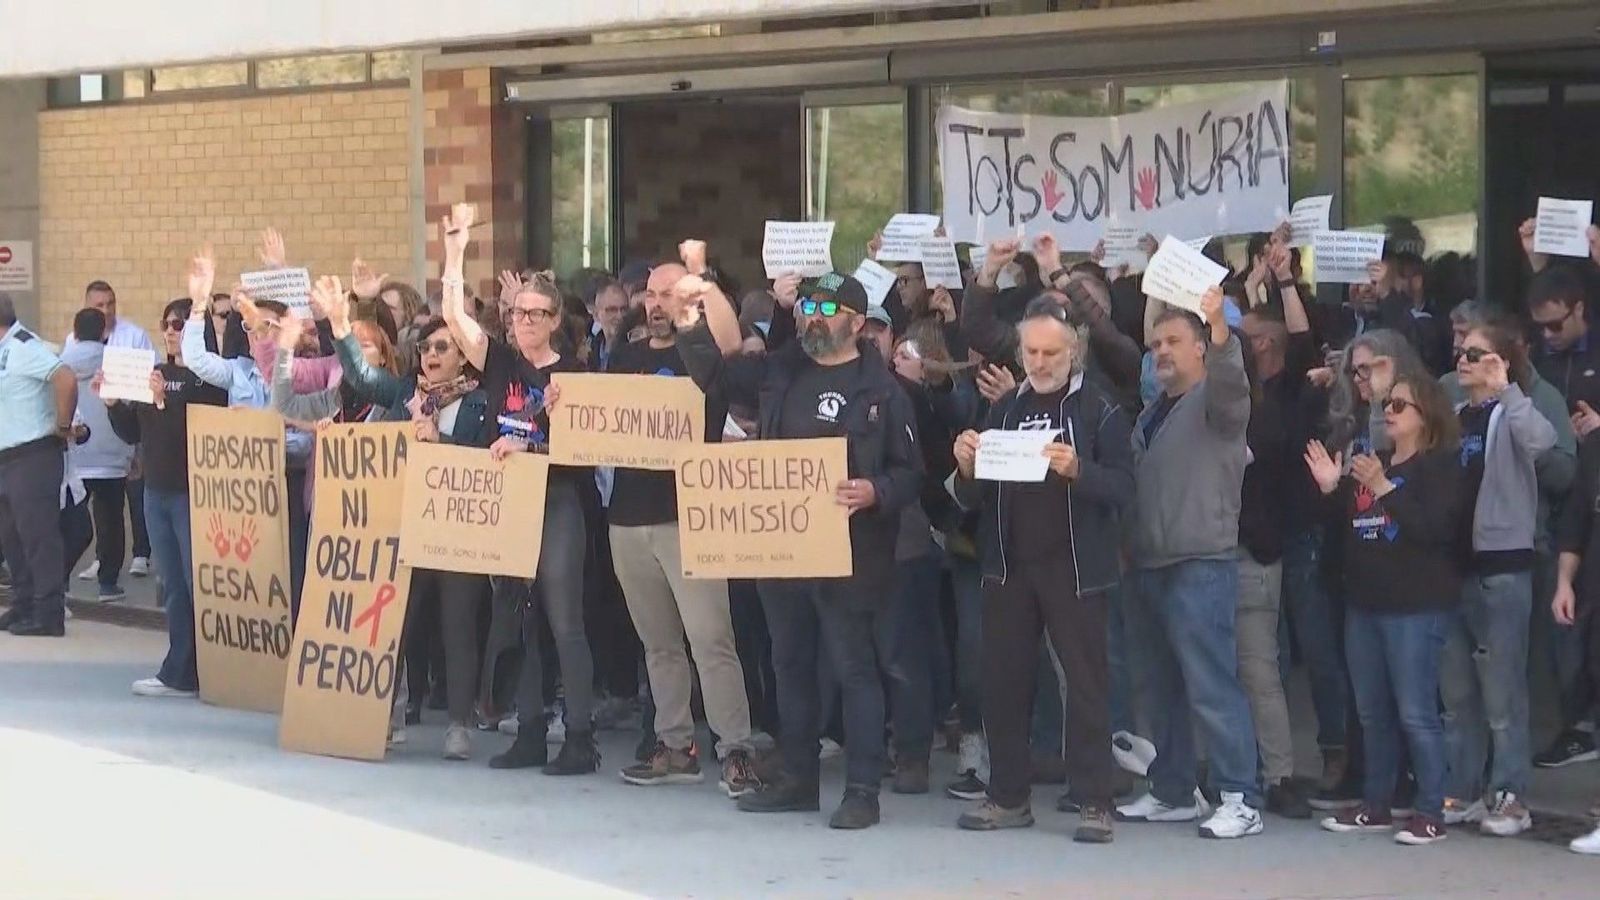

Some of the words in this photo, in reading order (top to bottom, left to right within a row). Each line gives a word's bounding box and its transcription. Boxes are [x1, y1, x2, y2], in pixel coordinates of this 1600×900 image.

[1155, 100, 1287, 208] NÚRIA
[565, 404, 607, 433] TOTS
[611, 405, 642, 434] SOM
[647, 403, 693, 442] NÚRIA
[194, 433, 279, 472] UBASART
[321, 427, 408, 480] NÚRIA
[194, 473, 279, 518] DIMISSIÓ
[425, 463, 506, 496] CALDERÓ
[681, 457, 830, 493] CONSELLERA
[341, 487, 368, 529] NI
[422, 499, 436, 521] A
[446, 494, 503, 526] PRESÓ
[688, 496, 810, 535] DIMISSIÓ
[199, 563, 259, 604] CESA
[268, 573, 289, 608] A
[201, 607, 291, 660] CALDERÓ
[325, 590, 353, 634] NI
[297, 638, 396, 700] PERDÓ
